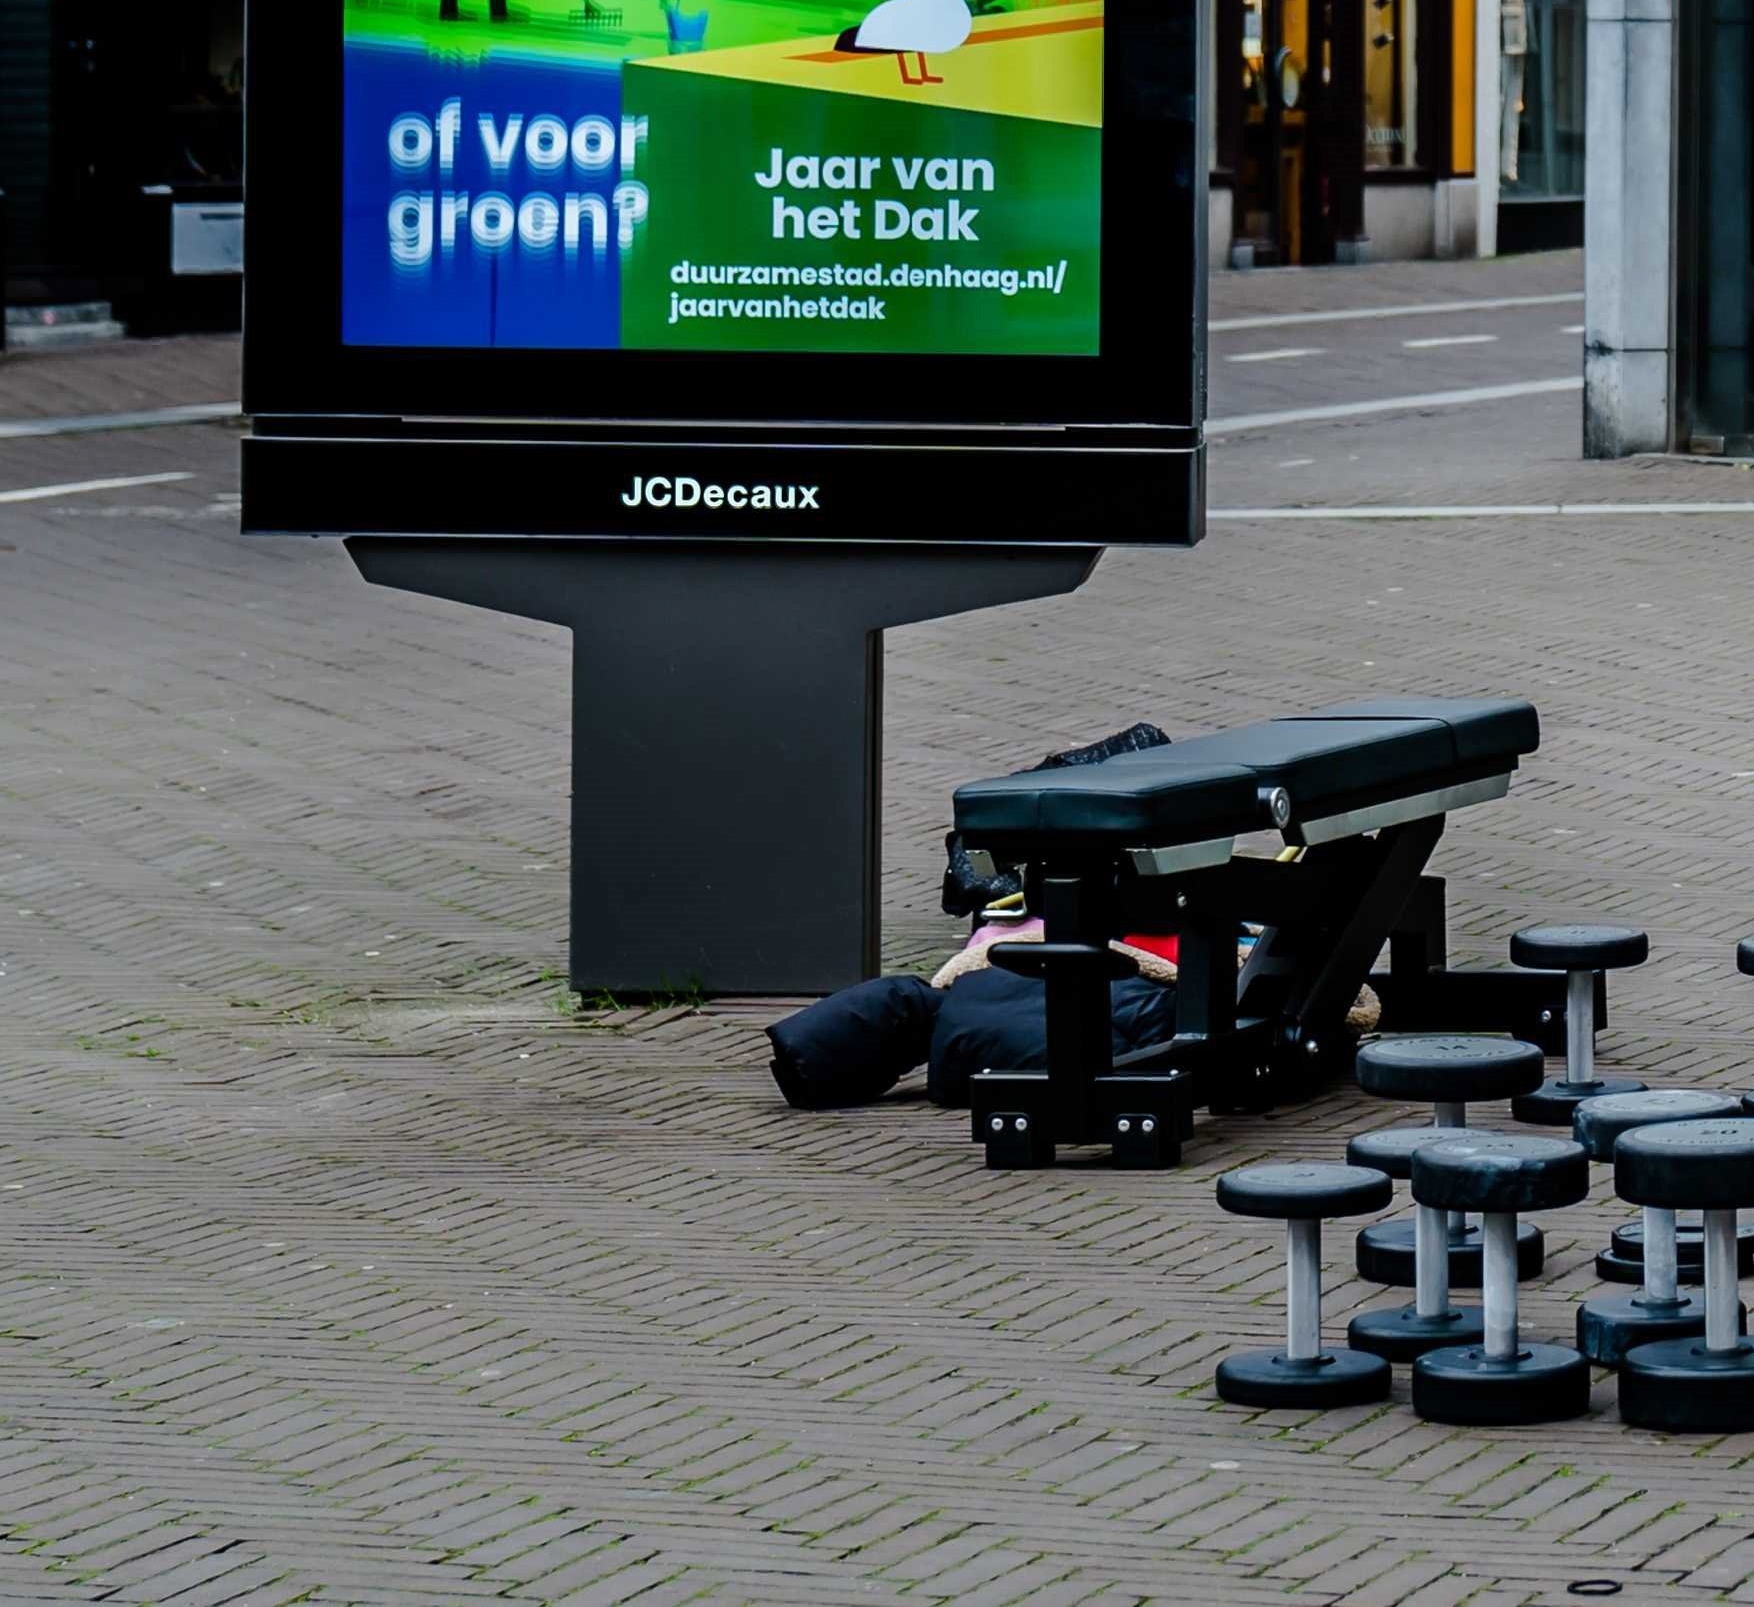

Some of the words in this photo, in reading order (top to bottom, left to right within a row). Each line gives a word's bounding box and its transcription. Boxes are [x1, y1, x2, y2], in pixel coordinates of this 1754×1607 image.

[389, 97, 461, 173] of
[479, 112, 648, 174] voor
[755, 148, 881, 191] Jaar
[891, 157, 995, 192] van
[389, 179, 648, 266] groen?
[771, 196, 861, 240] het
[875, 198, 979, 243] Dak
[670, 260, 1067, 295] duurzamestad.denhaag.nl/
[669, 295, 885, 324] jaarvanhetdak
[622, 476, 819, 509] JCDecaux
